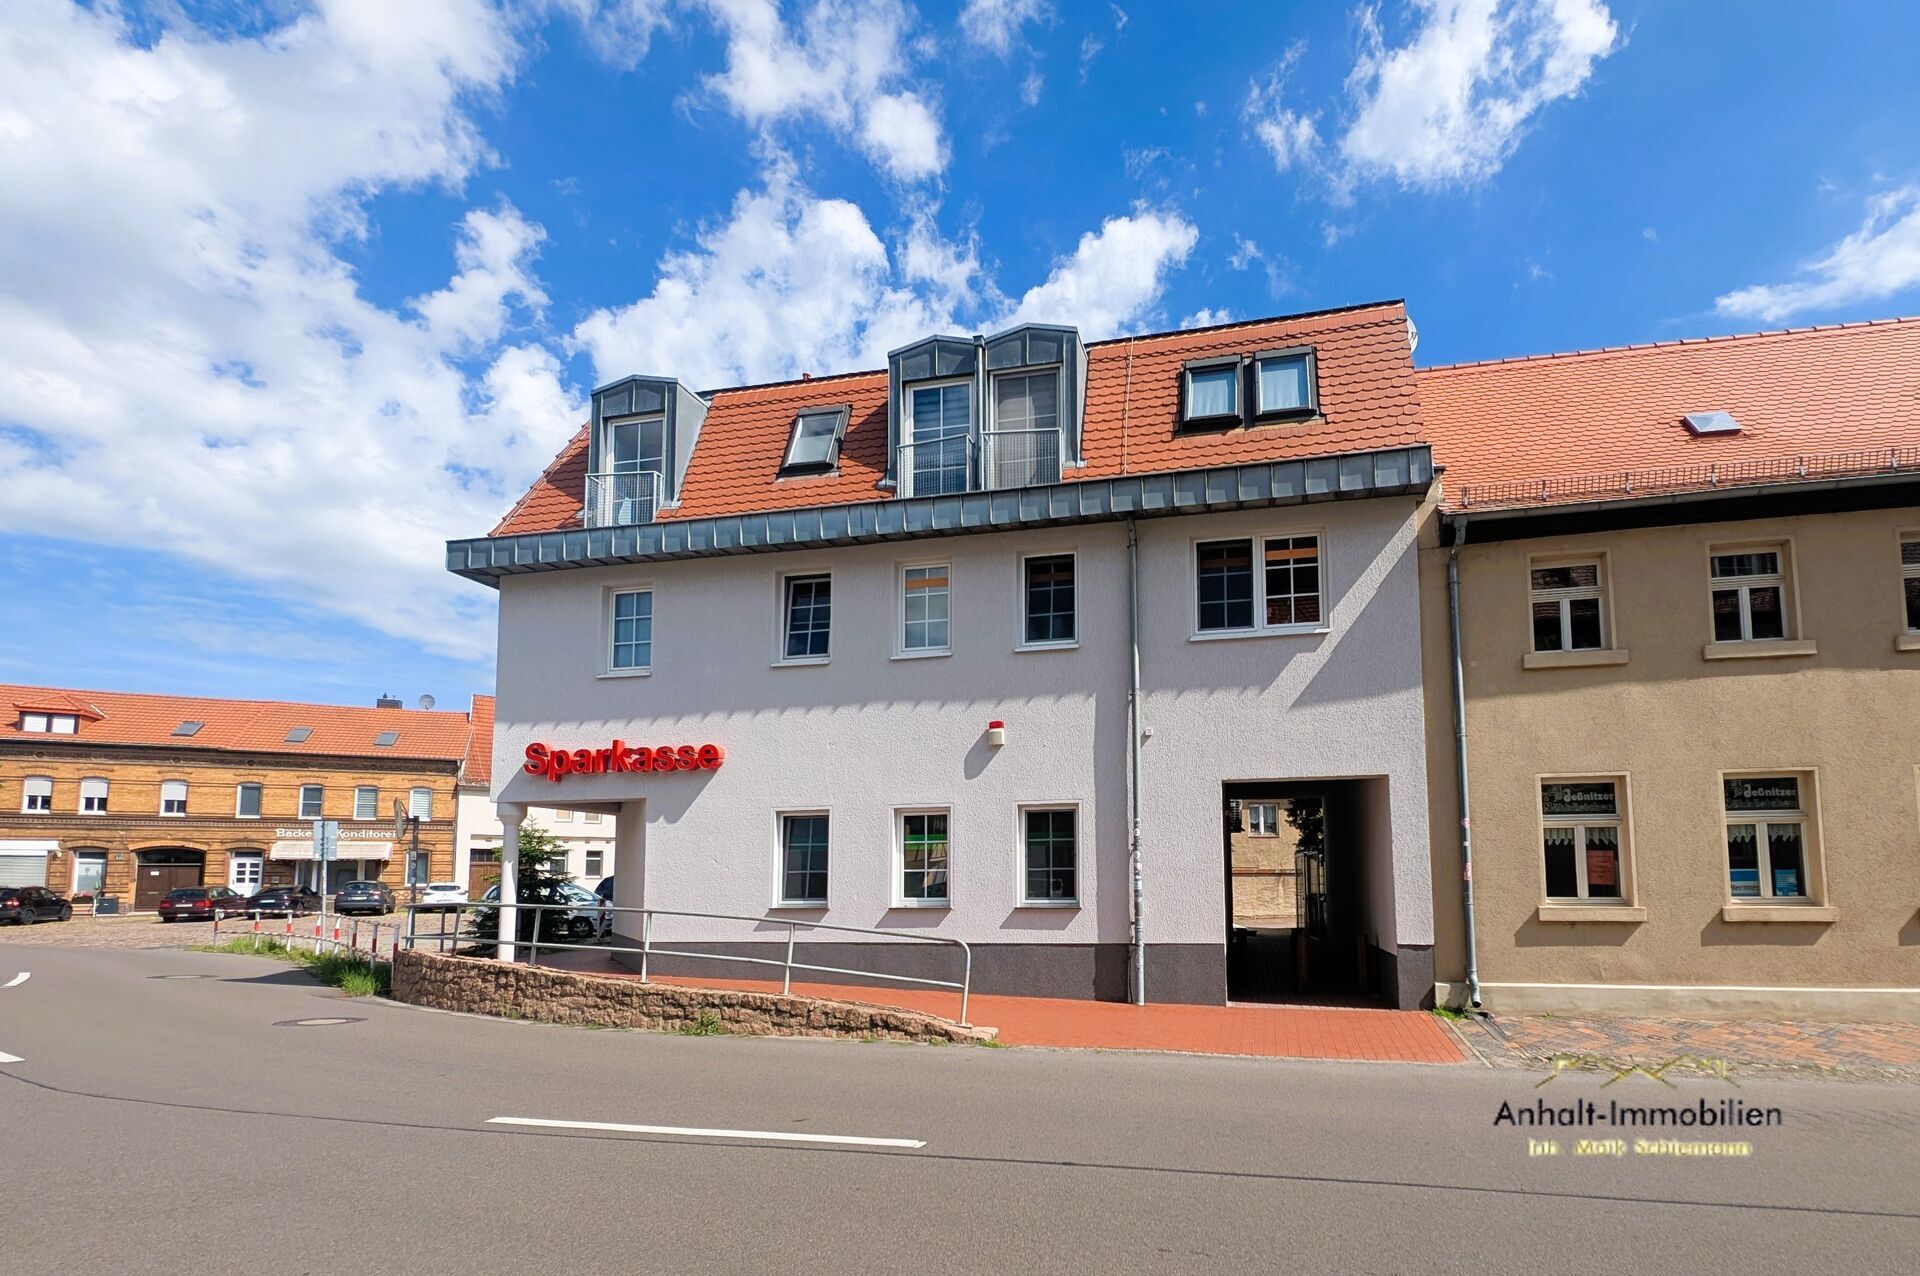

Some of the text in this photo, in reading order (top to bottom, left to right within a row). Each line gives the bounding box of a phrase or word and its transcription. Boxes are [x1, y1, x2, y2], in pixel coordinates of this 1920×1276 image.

[524, 740, 724, 782] Sparkasse
[275, 828, 396, 839] Bäcke Konditorei
